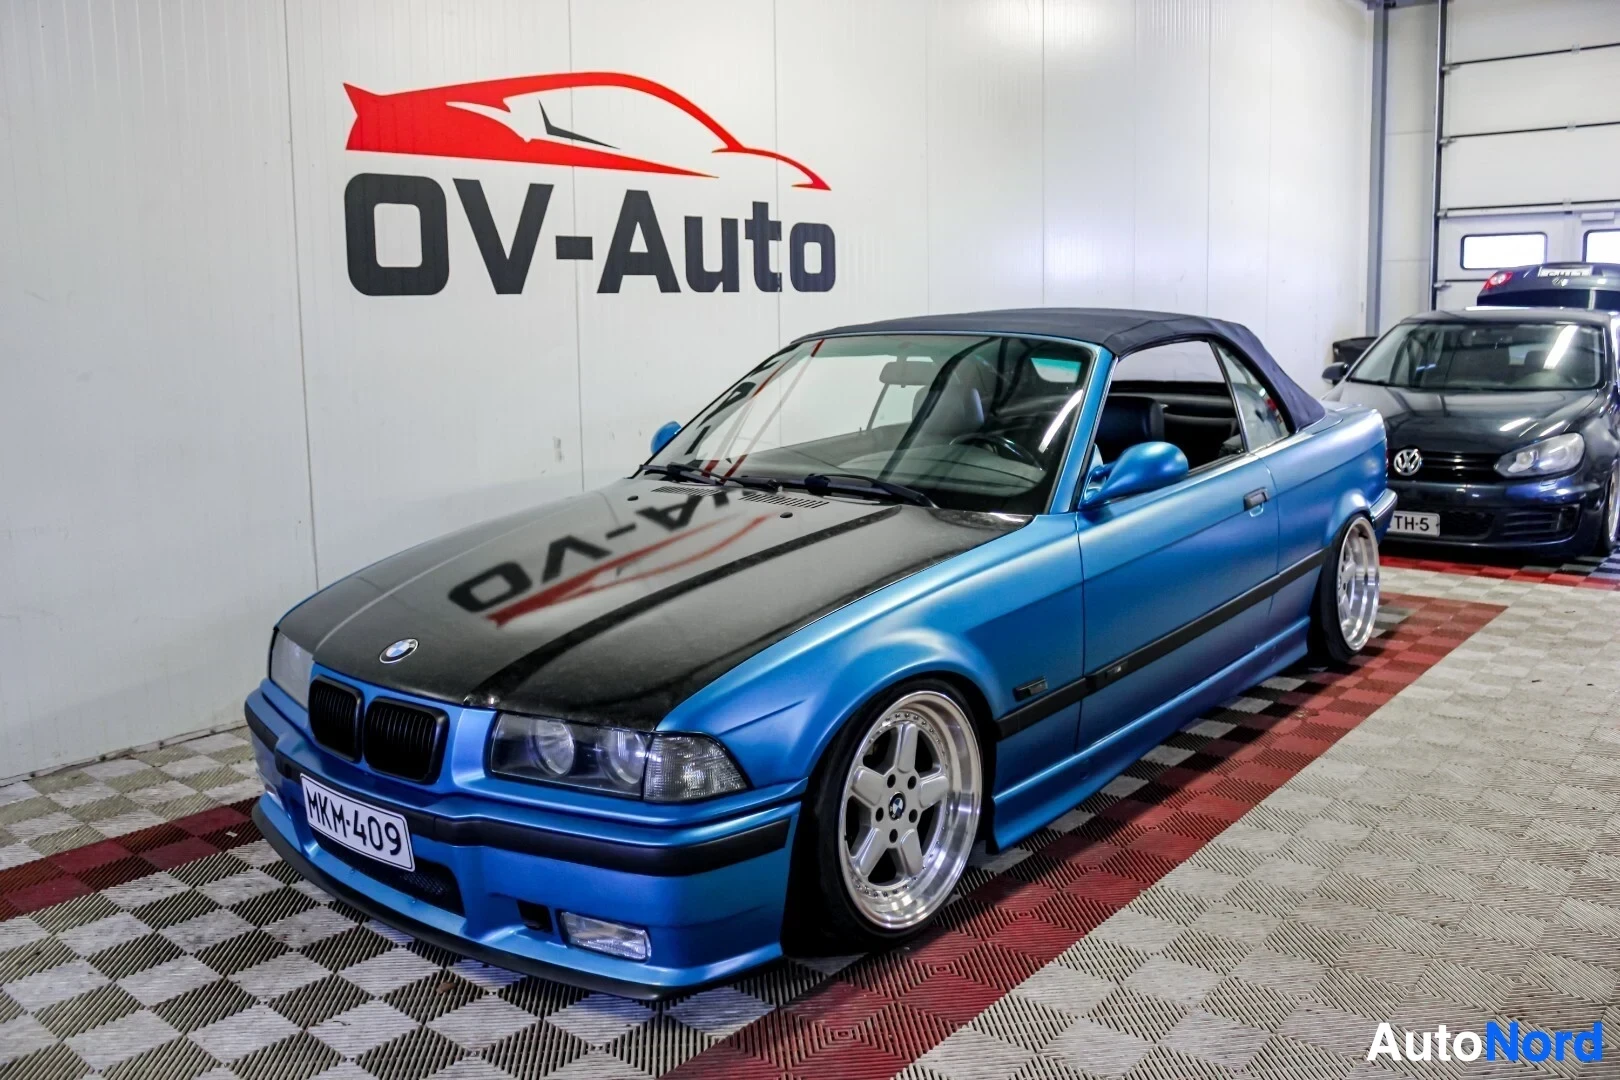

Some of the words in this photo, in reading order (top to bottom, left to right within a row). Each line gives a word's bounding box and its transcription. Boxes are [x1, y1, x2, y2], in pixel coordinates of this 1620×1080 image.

[344, 172, 836, 296] OV-Auto
[1394, 515, 1430, 531] TH-5
[305, 786, 402, 856] MKM-409
